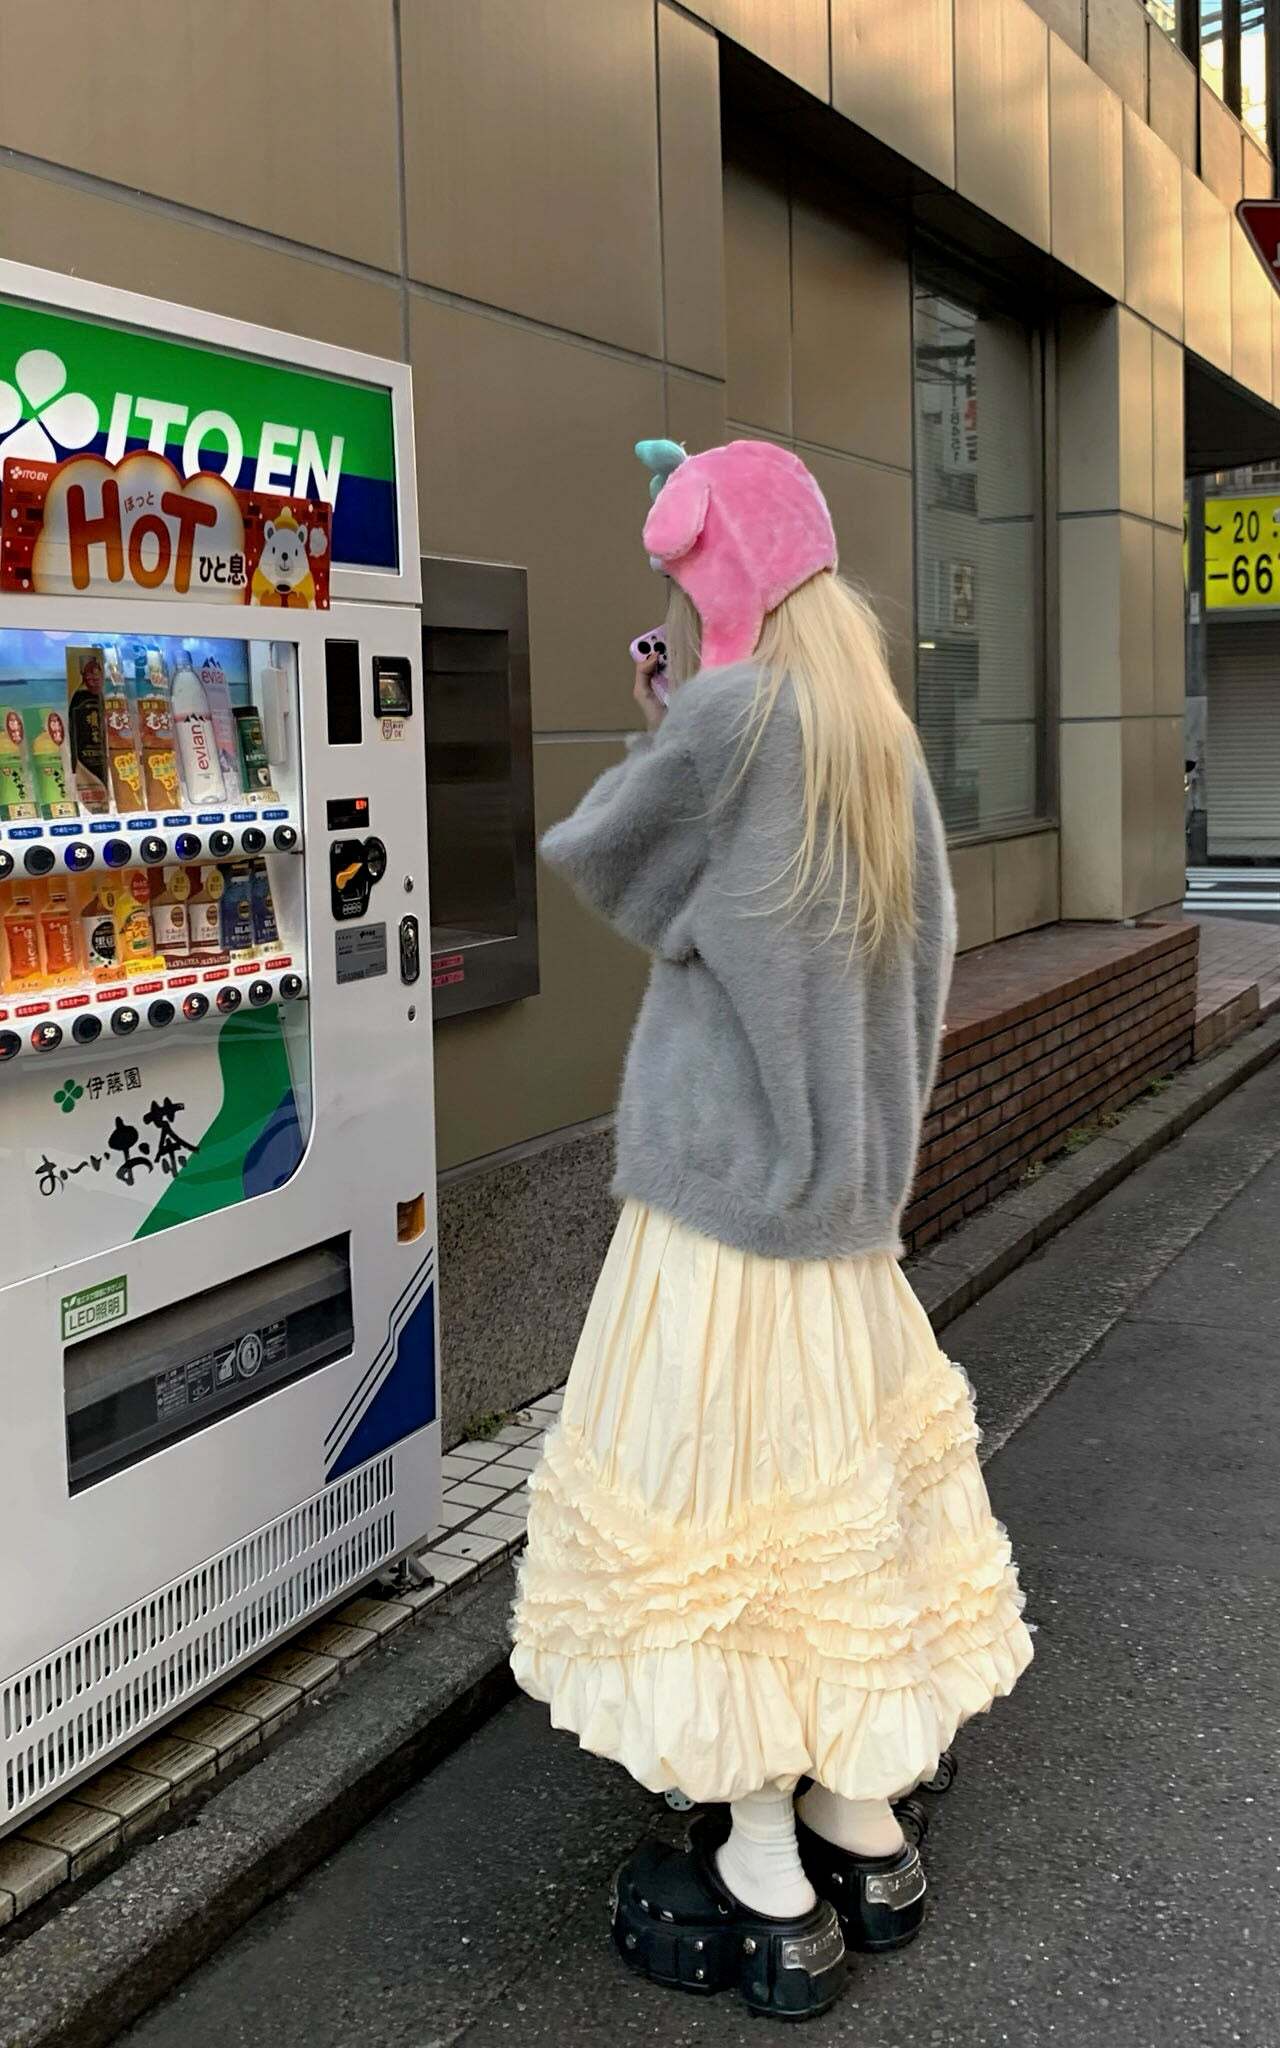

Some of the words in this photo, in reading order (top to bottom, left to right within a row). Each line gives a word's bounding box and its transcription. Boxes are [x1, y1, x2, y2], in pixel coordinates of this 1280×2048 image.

[105, 392, 243, 488] ITO
[254, 421, 345, 512] EN
[124, 491, 155, 513] ほっと
[199, 554, 248, 587] ひと息
[1208, 553, 1280, 595] -66
[191, 724, 209, 770] evian
[86, 1067, 141, 1100] 伊藤園
[70, 1295, 120, 1331] LED照明
